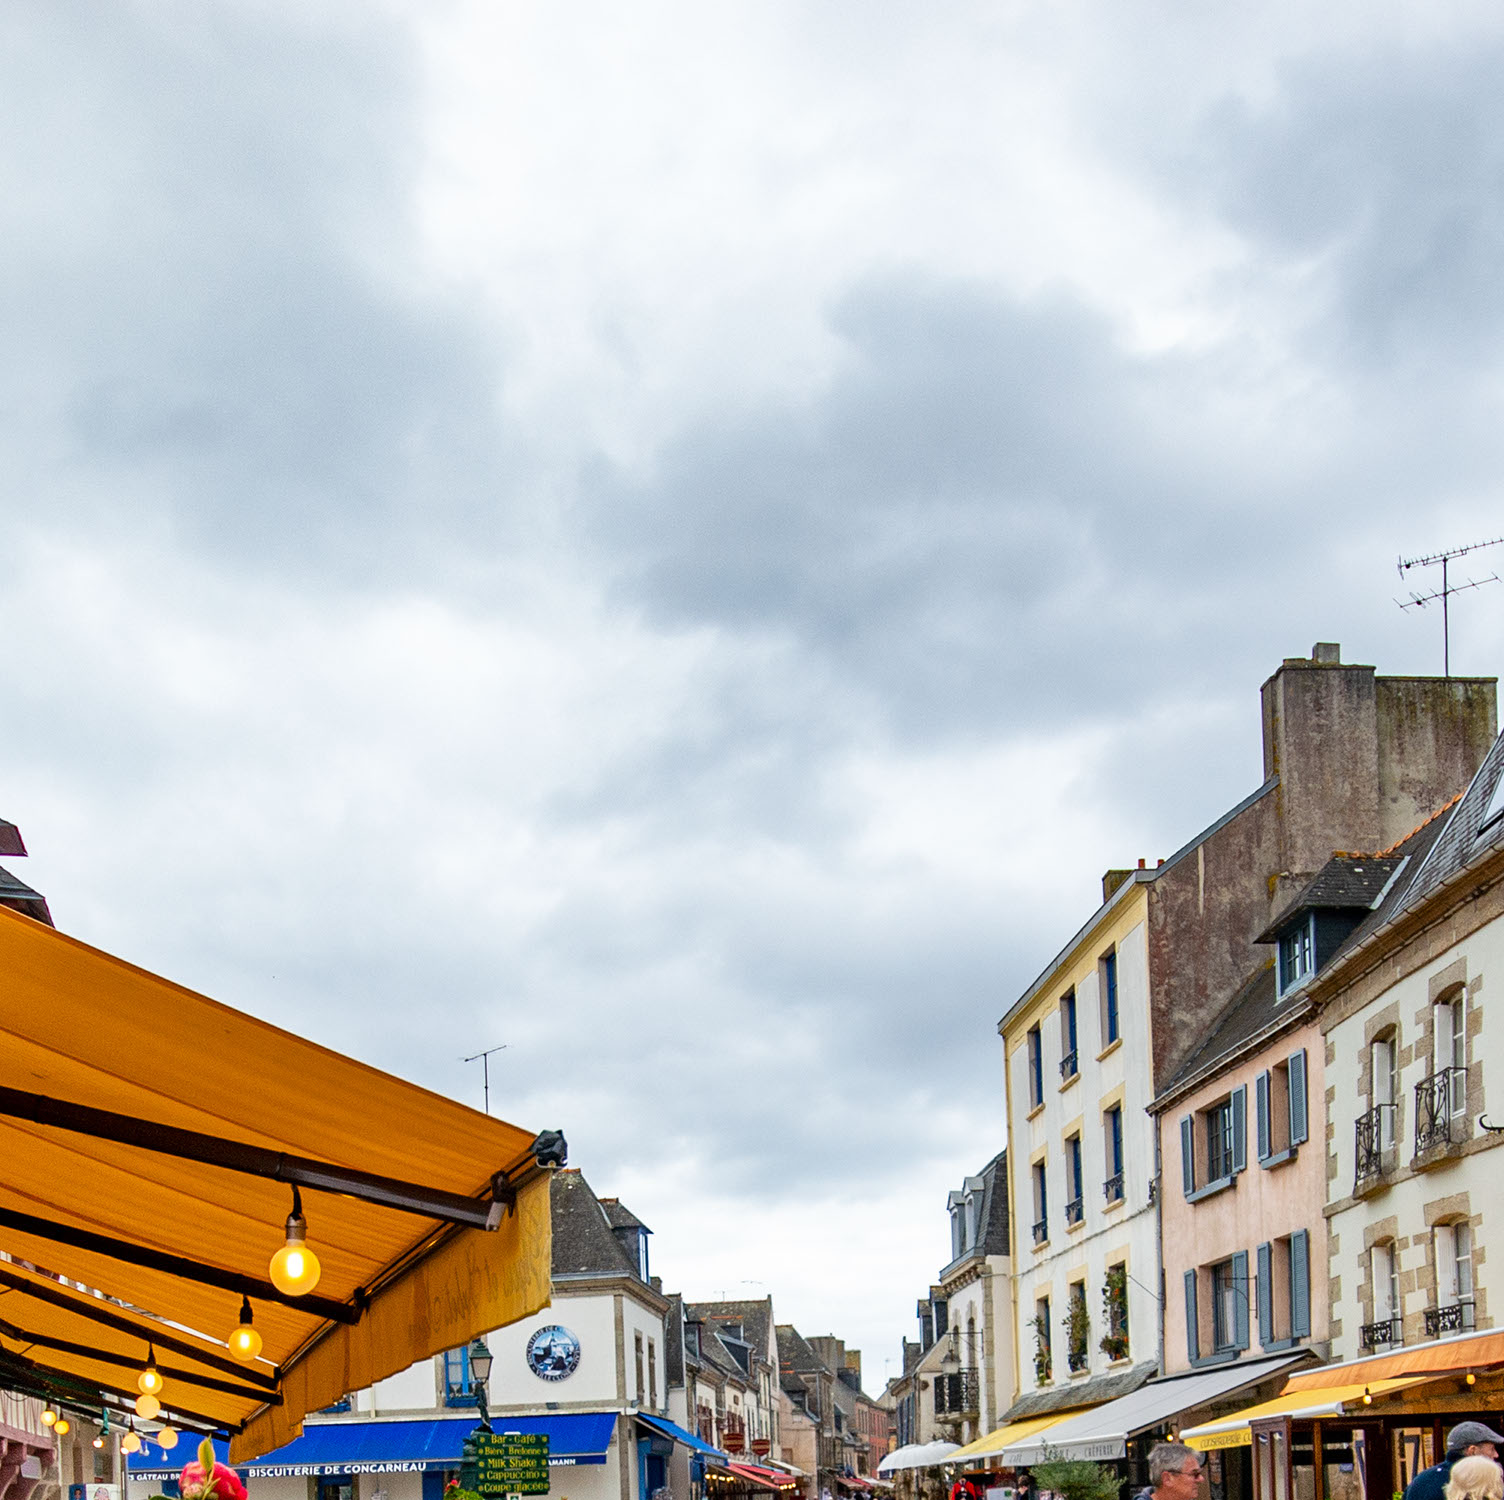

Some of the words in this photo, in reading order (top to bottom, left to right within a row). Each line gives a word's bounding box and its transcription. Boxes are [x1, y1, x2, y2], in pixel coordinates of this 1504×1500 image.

[491, 1434, 508, 1444] Bar
[514, 1434, 536, 1444] Café
[484, 1446, 505, 1455] Bière
[508, 1446, 541, 1455] Bretonne
[487, 1458, 506, 1468] Milk
[509, 1458, 537, 1467] Shake
[248, 1466, 320, 1478] BISCUITERIE
[324, 1465, 340, 1475] DE
[344, 1462, 427, 1474] CONCARNEAU
[136, 1472, 168, 1481] GÂTEAU
[486, 1470, 540, 1481] Cappuccino
[484, 1483, 511, 1493] Coupe
[513, 1482, 544, 1493] glacée
